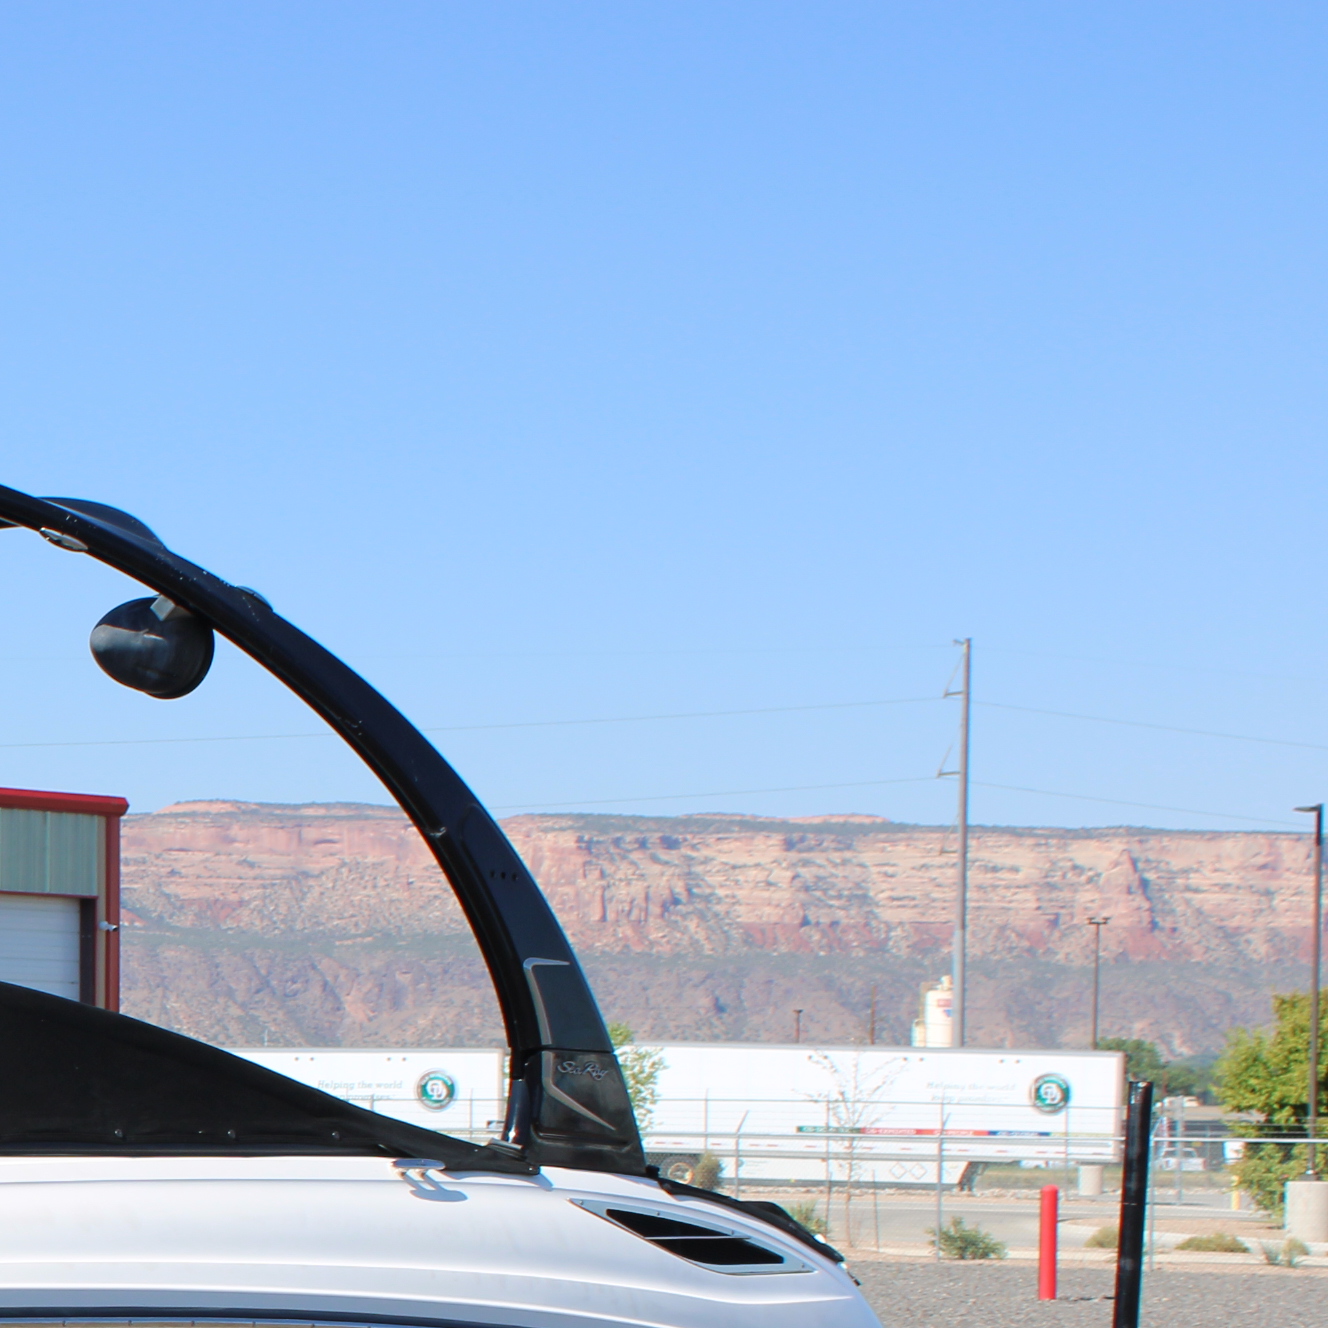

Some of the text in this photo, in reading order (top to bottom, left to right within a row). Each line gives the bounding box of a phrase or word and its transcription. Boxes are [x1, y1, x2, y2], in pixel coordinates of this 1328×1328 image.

[317, 1080, 403, 1090] Helping the world
